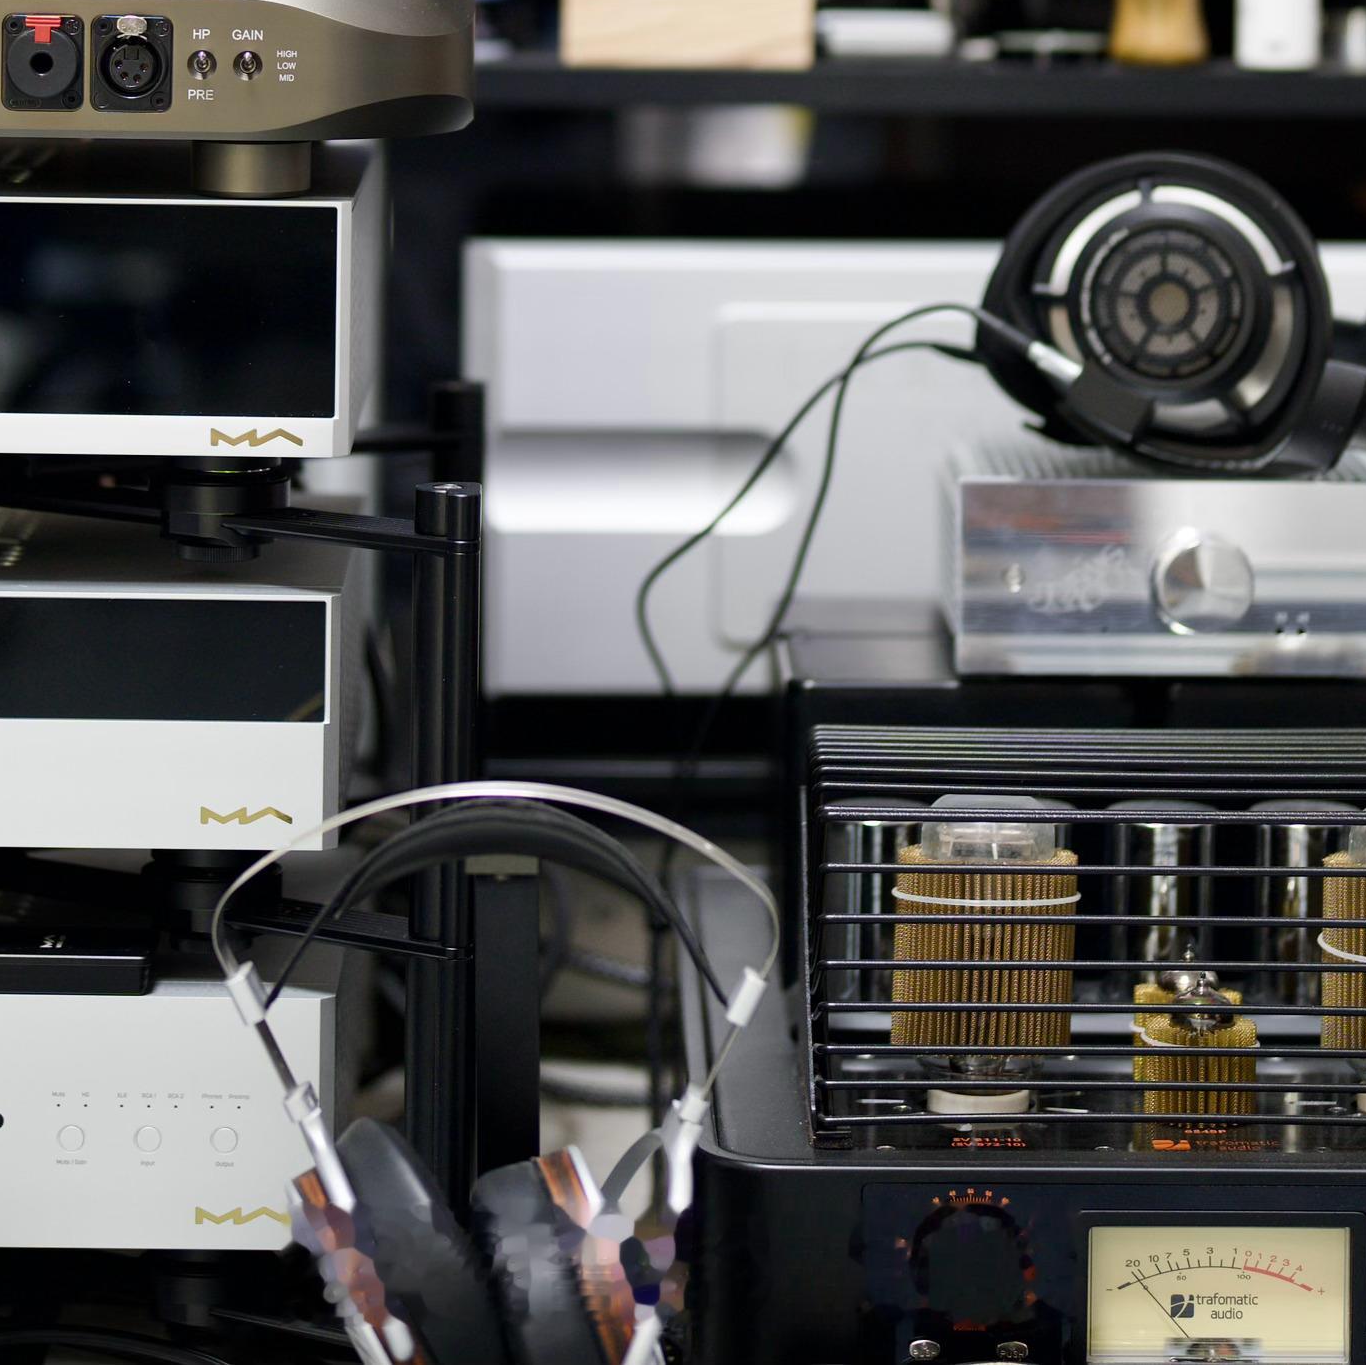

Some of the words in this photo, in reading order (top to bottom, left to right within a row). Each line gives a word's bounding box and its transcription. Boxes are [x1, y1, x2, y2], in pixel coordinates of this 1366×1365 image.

[192, 28, 211, 40] HP
[231, 29, 264, 41] GAIN
[276, 50, 298, 58] HIGH
[276, 62, 297, 70] LOW
[278, 73, 295, 82] MID
[187, 89, 215, 101] PRE
[1124, 1258, 1142, 1268] 20
[1148, 1253, 1160, 1264] 10
[1164, 1251, 1173, 1260] 7
[1182, 1248, 1191, 1257] 5
[1205, 1246, 1215, 1255] 3
[1244, 1249, 1253, 1258] 0
[1269, 1254, 1278, 1263] 2
[1282, 1258, 1291, 1267] 3
[1196, 1292, 1259, 1306] trafomatic
[1210, 1308, 1244, 1320] audio
